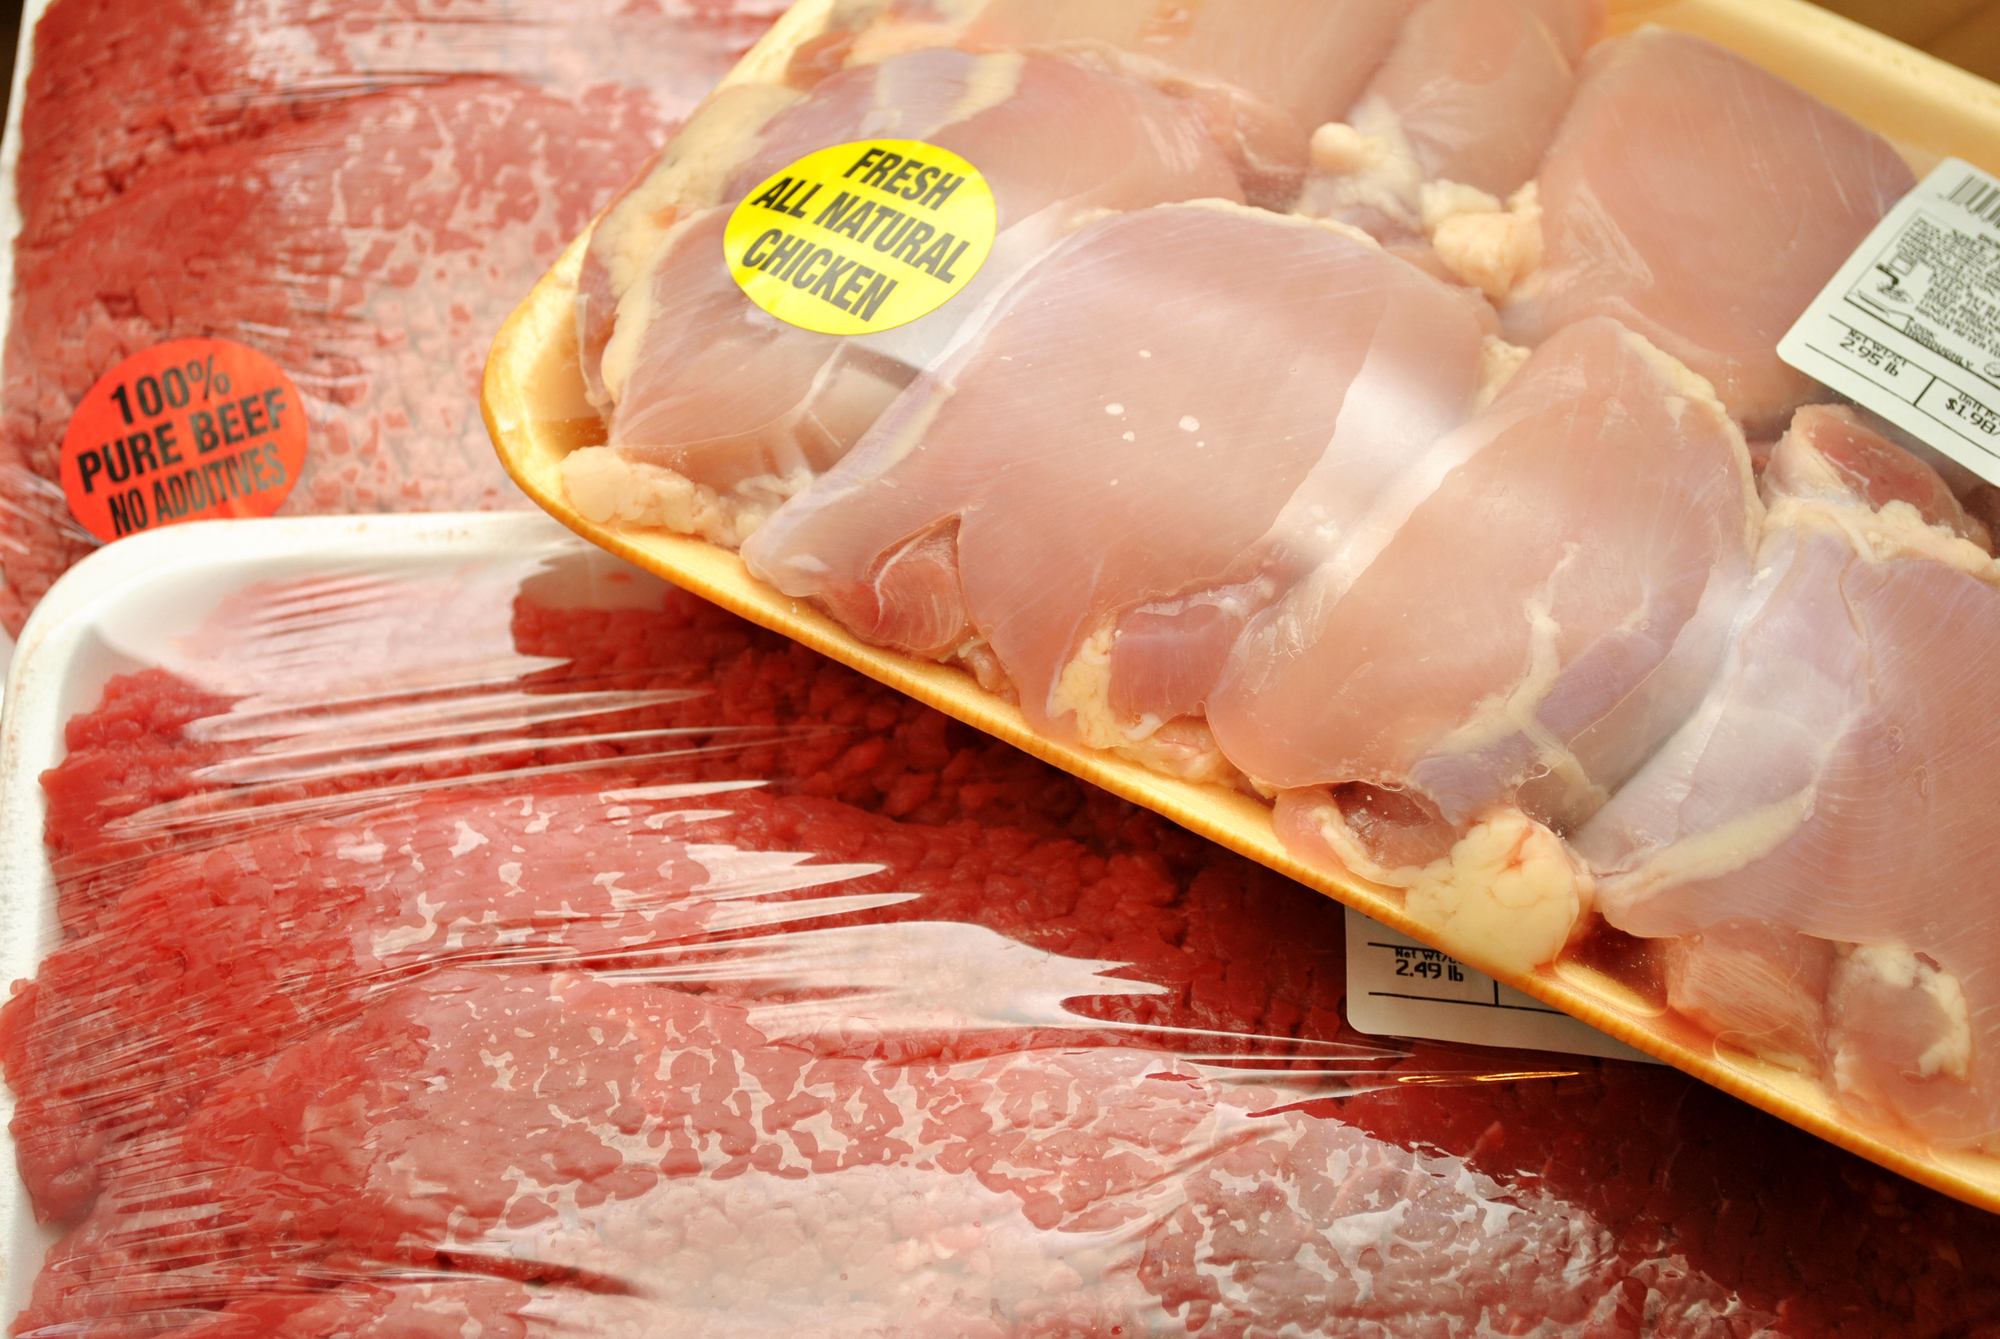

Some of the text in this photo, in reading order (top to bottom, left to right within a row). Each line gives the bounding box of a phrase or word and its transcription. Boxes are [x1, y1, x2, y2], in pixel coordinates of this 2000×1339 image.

[842, 147, 965, 211] FRESH
[749, 176, 971, 284] ALL NATURAL
[740, 227, 899, 322] CHICKEN
[110, 355, 231, 425] 100%
[1839, 336, 1899, 377] 2.95 lb
[77, 386, 288, 494] PURE BEEF
[107, 441, 287, 537] NO ADDITIVES
[1395, 948, 1463, 965] Net Wt/C
[1395, 959, 1464, 982] 2.49 lb
